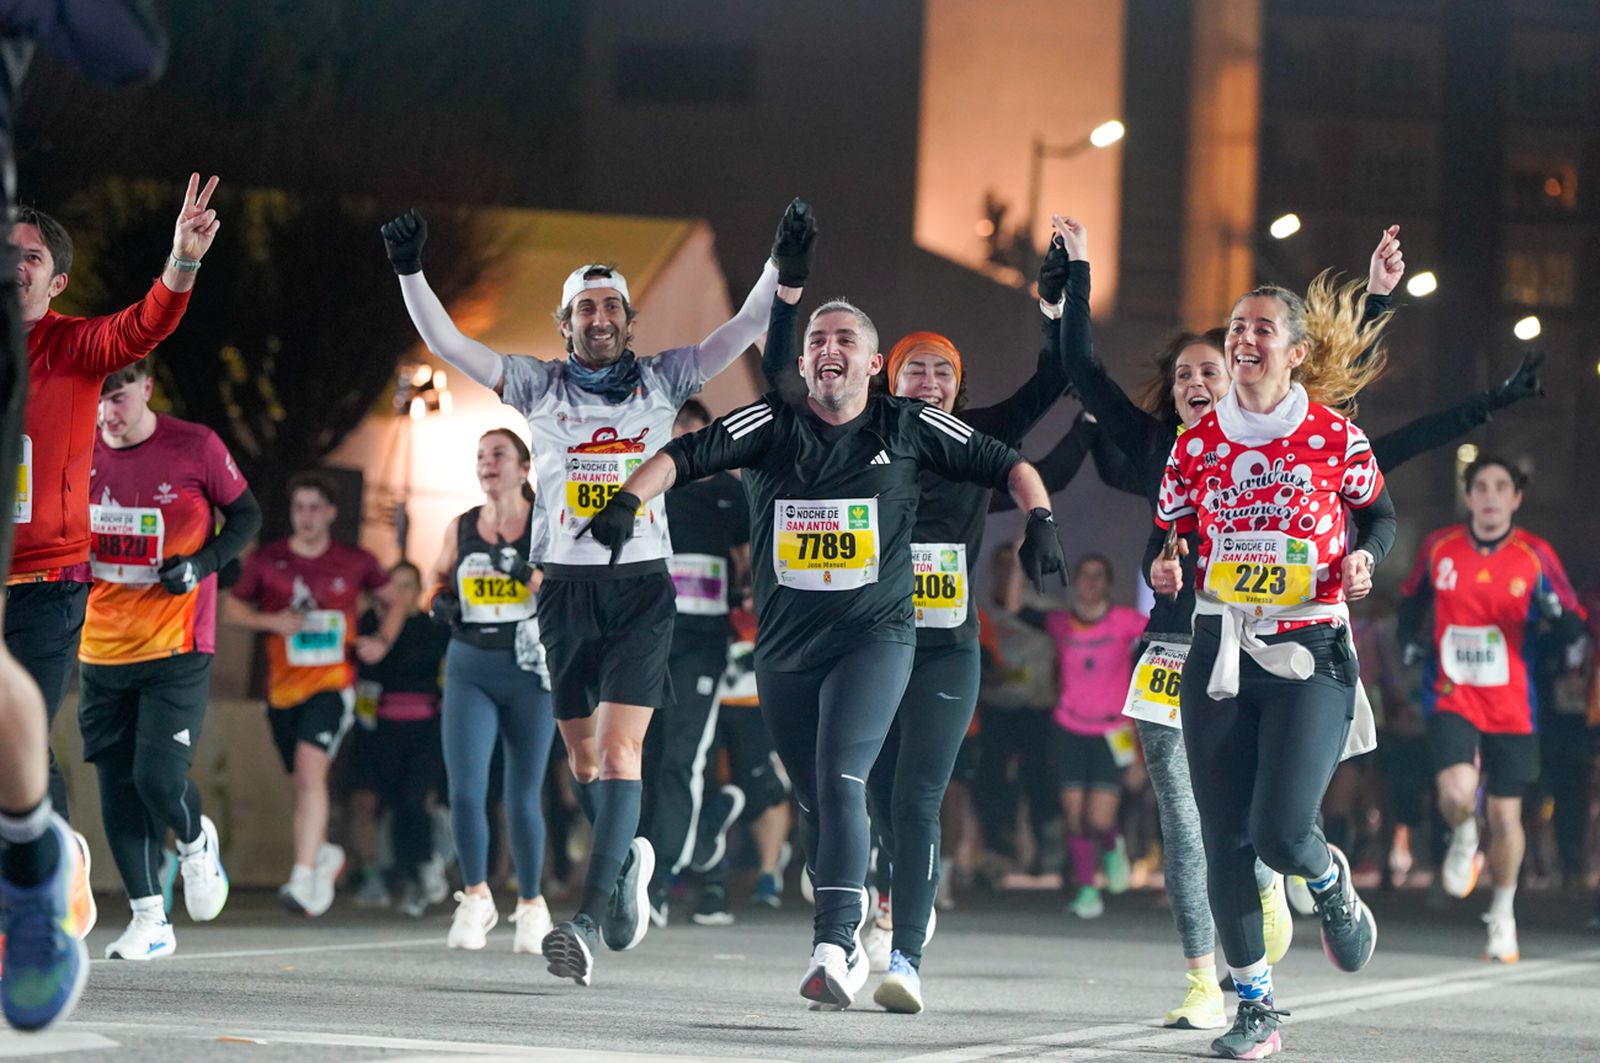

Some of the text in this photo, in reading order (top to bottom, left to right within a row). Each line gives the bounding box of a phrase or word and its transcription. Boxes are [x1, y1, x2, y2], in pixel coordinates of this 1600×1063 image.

[580, 463, 619, 472] NOCHE DE
[571, 471, 619, 482] SAN ANTÓN
[796, 509, 839, 519] NOCHE DE
[786, 521, 804, 531] SAN
[806, 518, 840, 531] ANTÓN
[796, 532, 856, 560] 7789
[1235, 542, 1277, 551] NOCHE DE
[922, 552, 932, 561] DE
[1221, 553, 1241, 562] SAN
[1242, 552, 1277, 564] ANTÓN
[1234, 564, 1286, 595] 223
[474, 578, 517, 597] 3123
[1148, 656, 1167, 668] SAN
